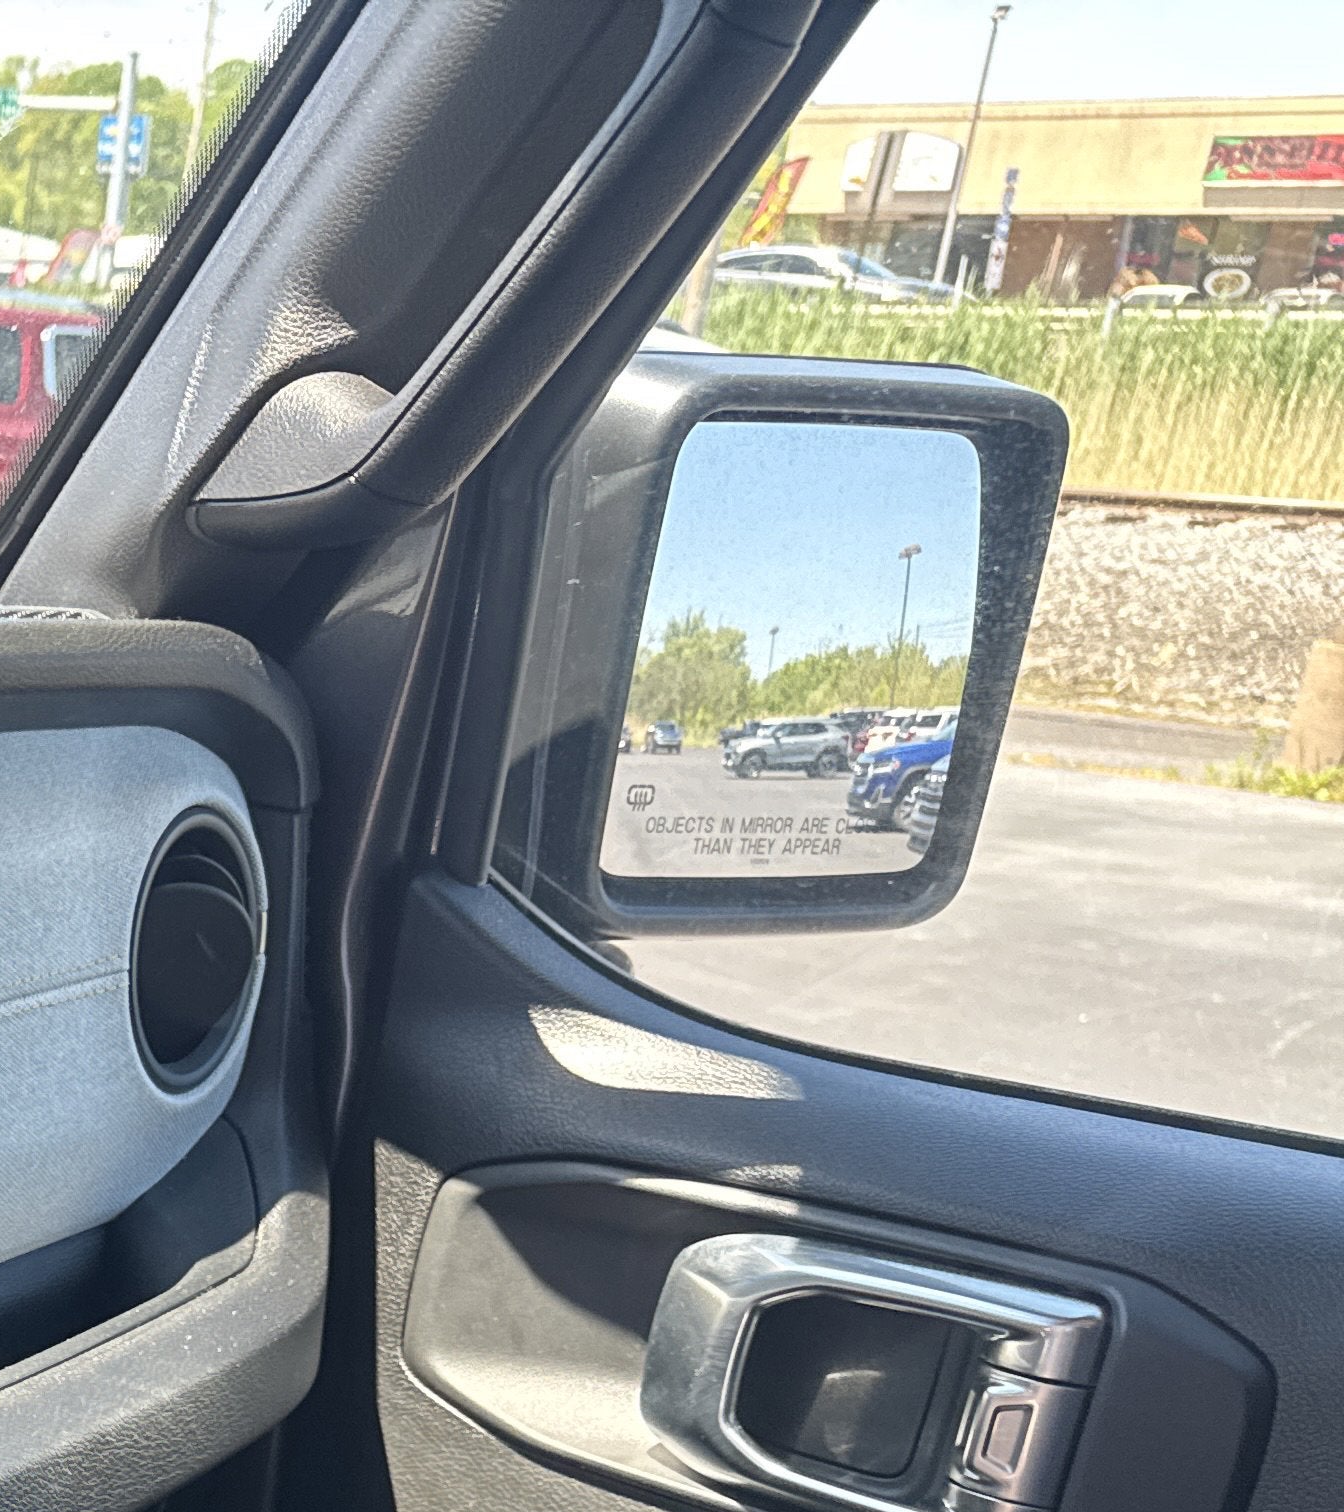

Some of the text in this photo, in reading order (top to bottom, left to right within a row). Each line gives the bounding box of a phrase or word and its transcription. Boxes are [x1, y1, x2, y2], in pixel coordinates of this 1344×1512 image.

[645, 816, 714, 834] OBJECTS
[720, 816, 736, 834] IN
[741, 816, 794, 834] MIRROR
[799, 816, 830, 834] ARE
[693, 837, 842, 855] THAN THEY APPEAR
